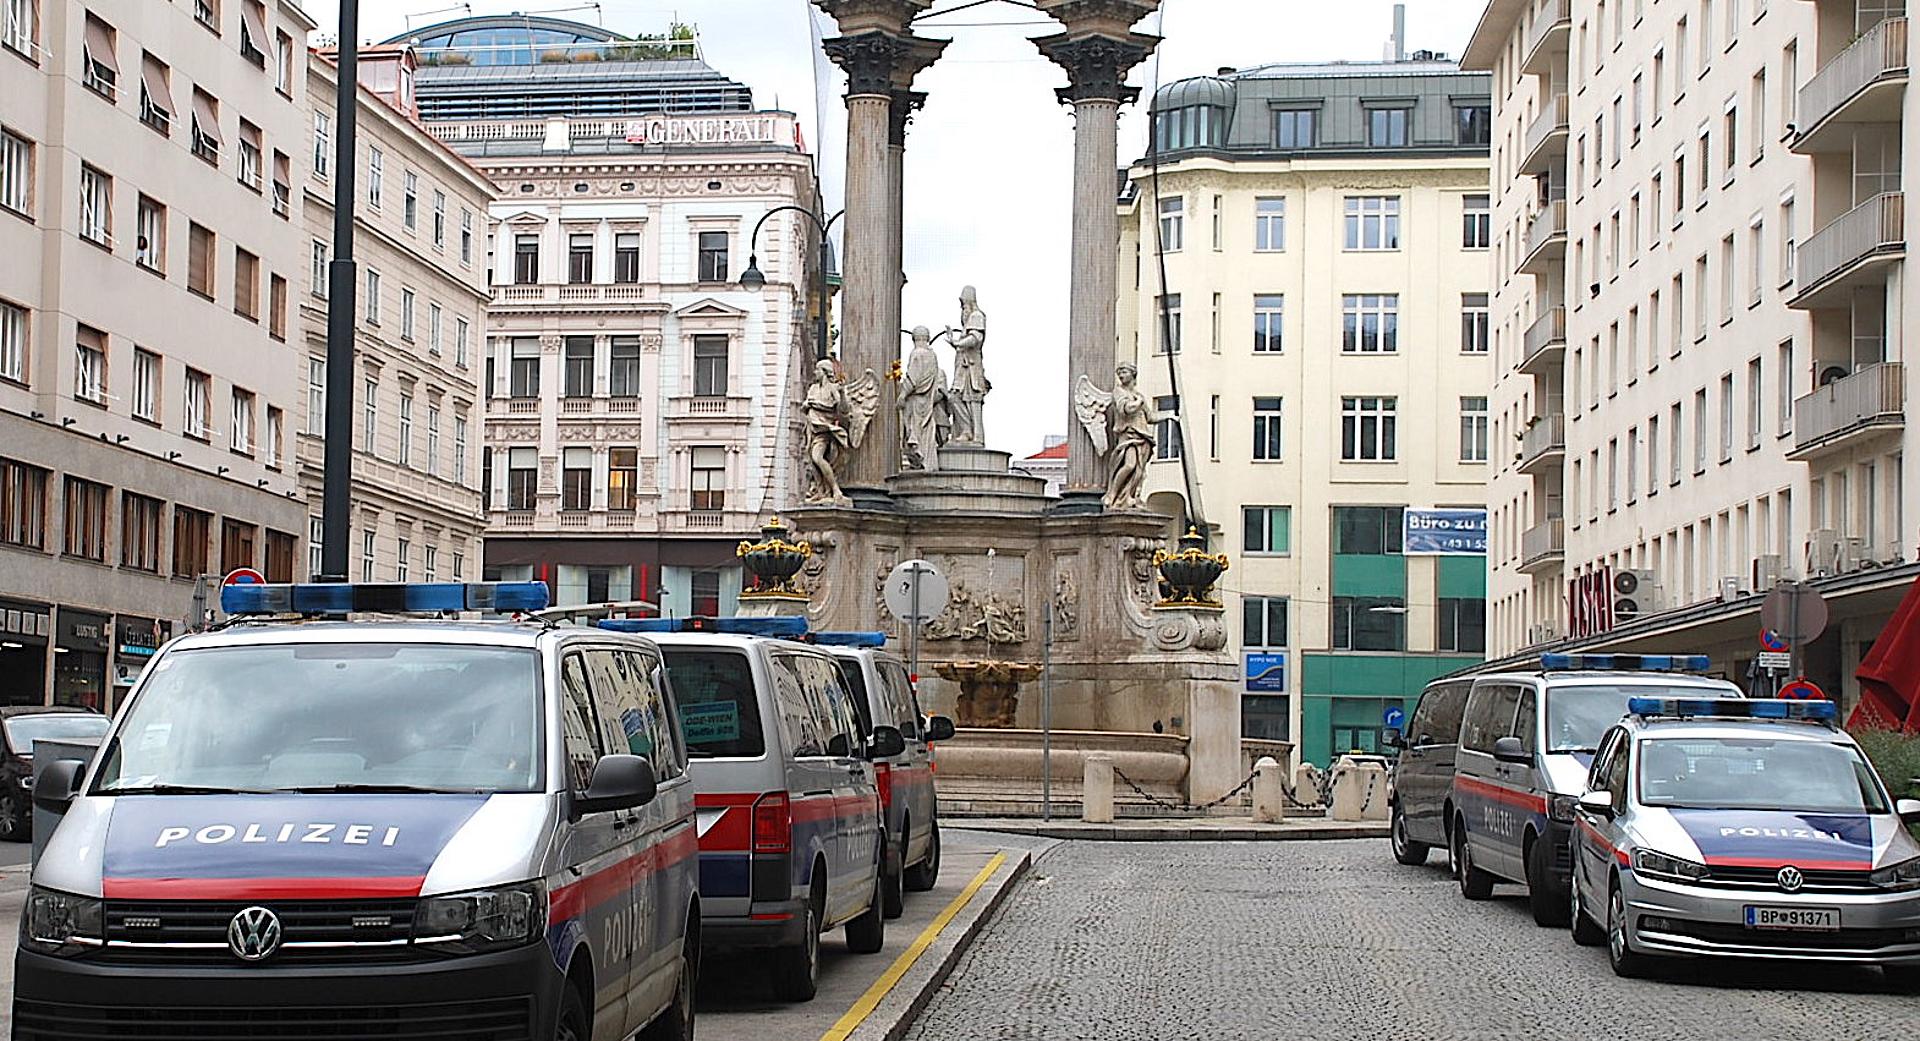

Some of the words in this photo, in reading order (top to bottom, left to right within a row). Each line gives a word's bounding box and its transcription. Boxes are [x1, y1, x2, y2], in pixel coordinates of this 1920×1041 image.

[646, 118, 776, 144] GENERALI
[1409, 514, 1450, 530] Büro
[1454, 520, 1475, 530] zu
[1484, 805, 1513, 838] POLIZEI
[1720, 827, 1841, 841] POLIZEI
[155, 823, 400, 848] POLIZEI
[602, 896, 648, 969] POLIZEI
